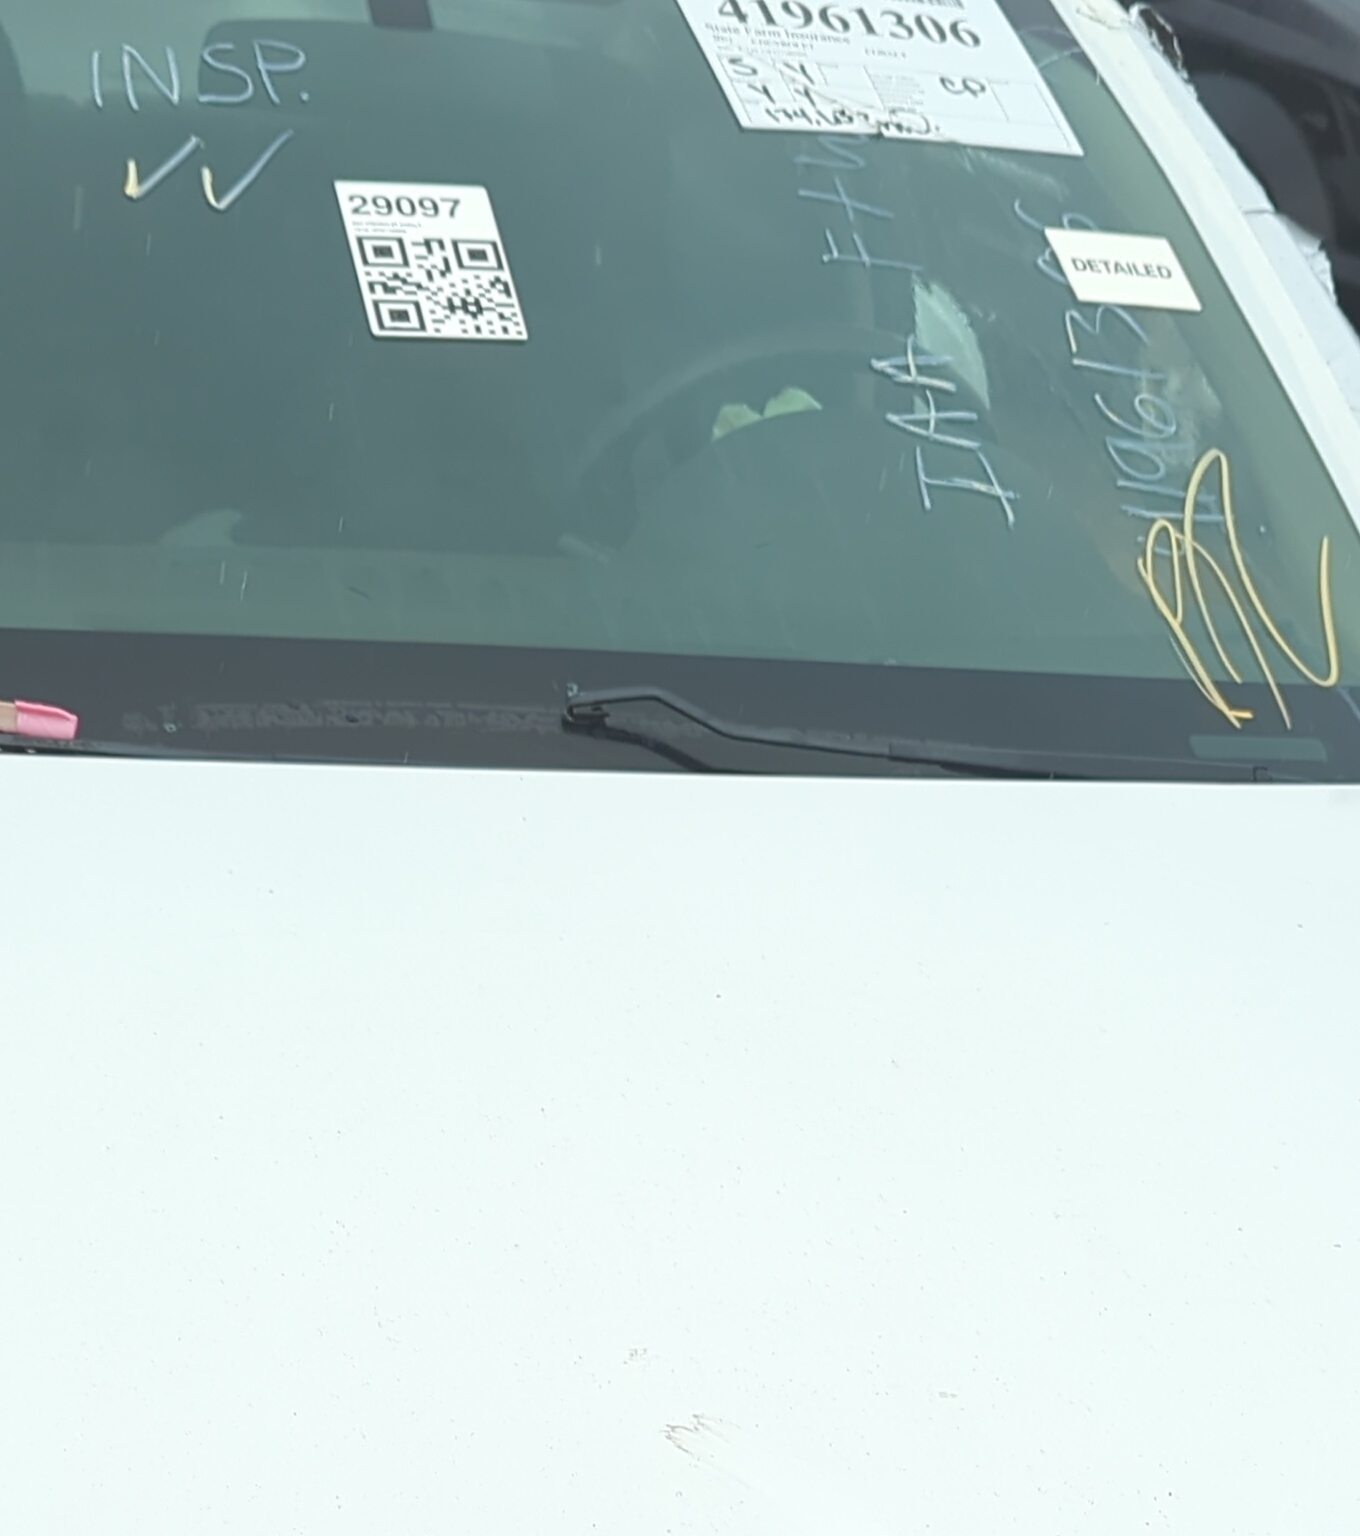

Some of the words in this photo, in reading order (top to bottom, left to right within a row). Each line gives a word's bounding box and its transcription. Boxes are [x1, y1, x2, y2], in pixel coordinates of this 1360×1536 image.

[718, 0, 982, 49] 41961306
[91, 41, 310, 106] INSP.
[348, 194, 460, 218] 29097
[1071, 257, 1172, 280] DETAILED
